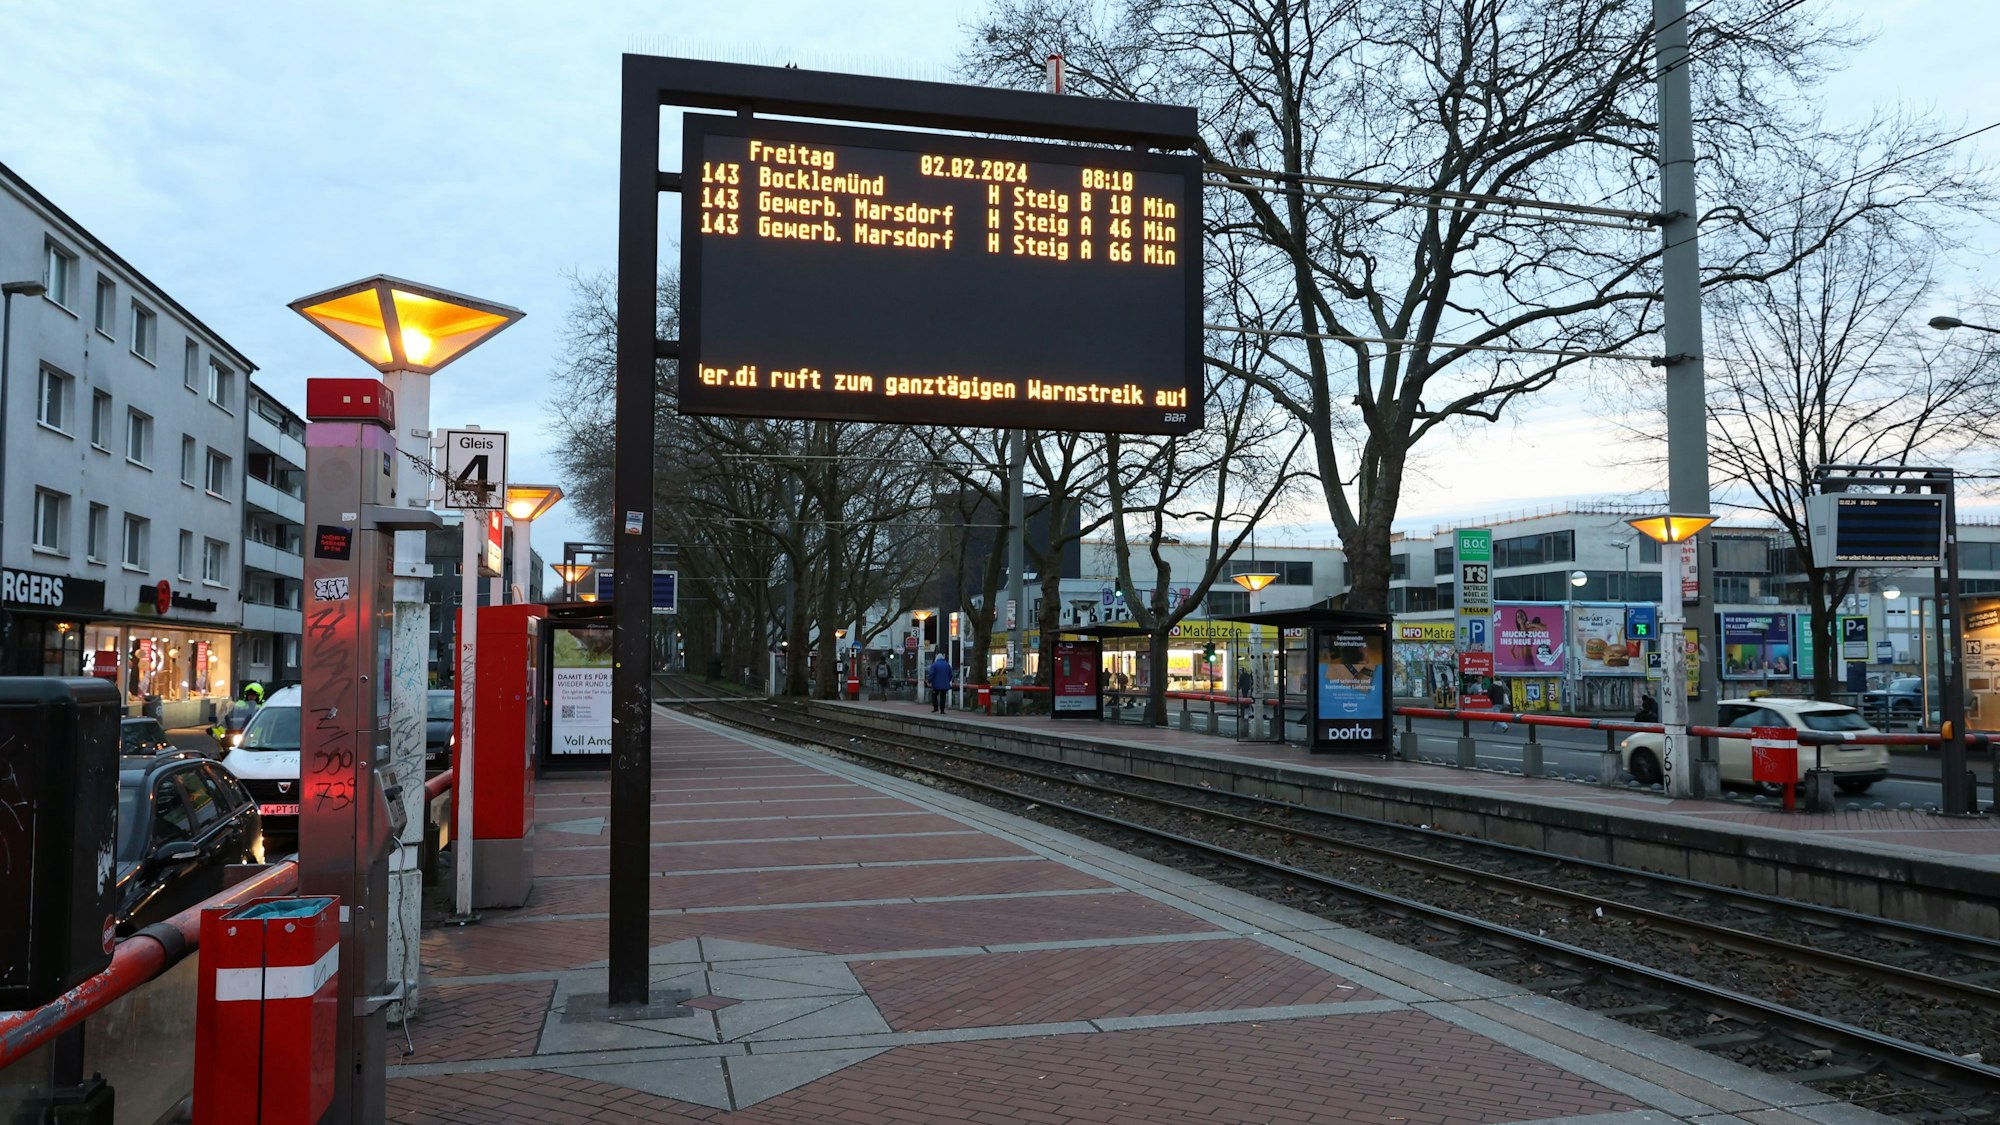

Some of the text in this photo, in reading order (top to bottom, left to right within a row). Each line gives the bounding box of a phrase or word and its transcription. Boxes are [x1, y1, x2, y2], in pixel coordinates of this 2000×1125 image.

[750, 141, 1133, 191] Freitag 02.02.2024 08:10
[701, 162, 1176, 219] 143 Bocklemünd H Steig B 10 Min
[701, 187, 1176, 242] 143 Gewerb. Marsdorf H Steig A 46 Min
[700, 212, 1176, 266] 143 Gewerb. Marsdorf H Steig A 66 Min
[699, 363, 757, 387] er.di
[771, 368, 821, 390] ruft
[834, 374, 873, 392] zum
[885, 376, 1016, 400] ganztägigen
[1028, 379, 1143, 405] Warnstreik
[1164, 413, 1186, 423] BBR
[460, 437, 493, 449] Gleis
[455, 455, 496, 502] 4
[1464, 566, 1487, 582] rs
[2, 570, 63, 607] RGERS
[1629, 609, 1635, 618] P
[912, 629, 918, 637] 3
[1183, 625, 1242, 637] Matratzen
[1403, 627, 1455, 639] MFO Matra
[1472, 622, 1483, 639] P
[1636, 624, 1646, 635] 75
[1846, 620, 1856, 636] P
[1967, 641, 1980, 653] rs
[1649, 654, 1657, 664] P
[594, 672, 608, 680] FÜR
[1328, 723, 1372, 740] porta
[564, 735, 584, 746] Voll
